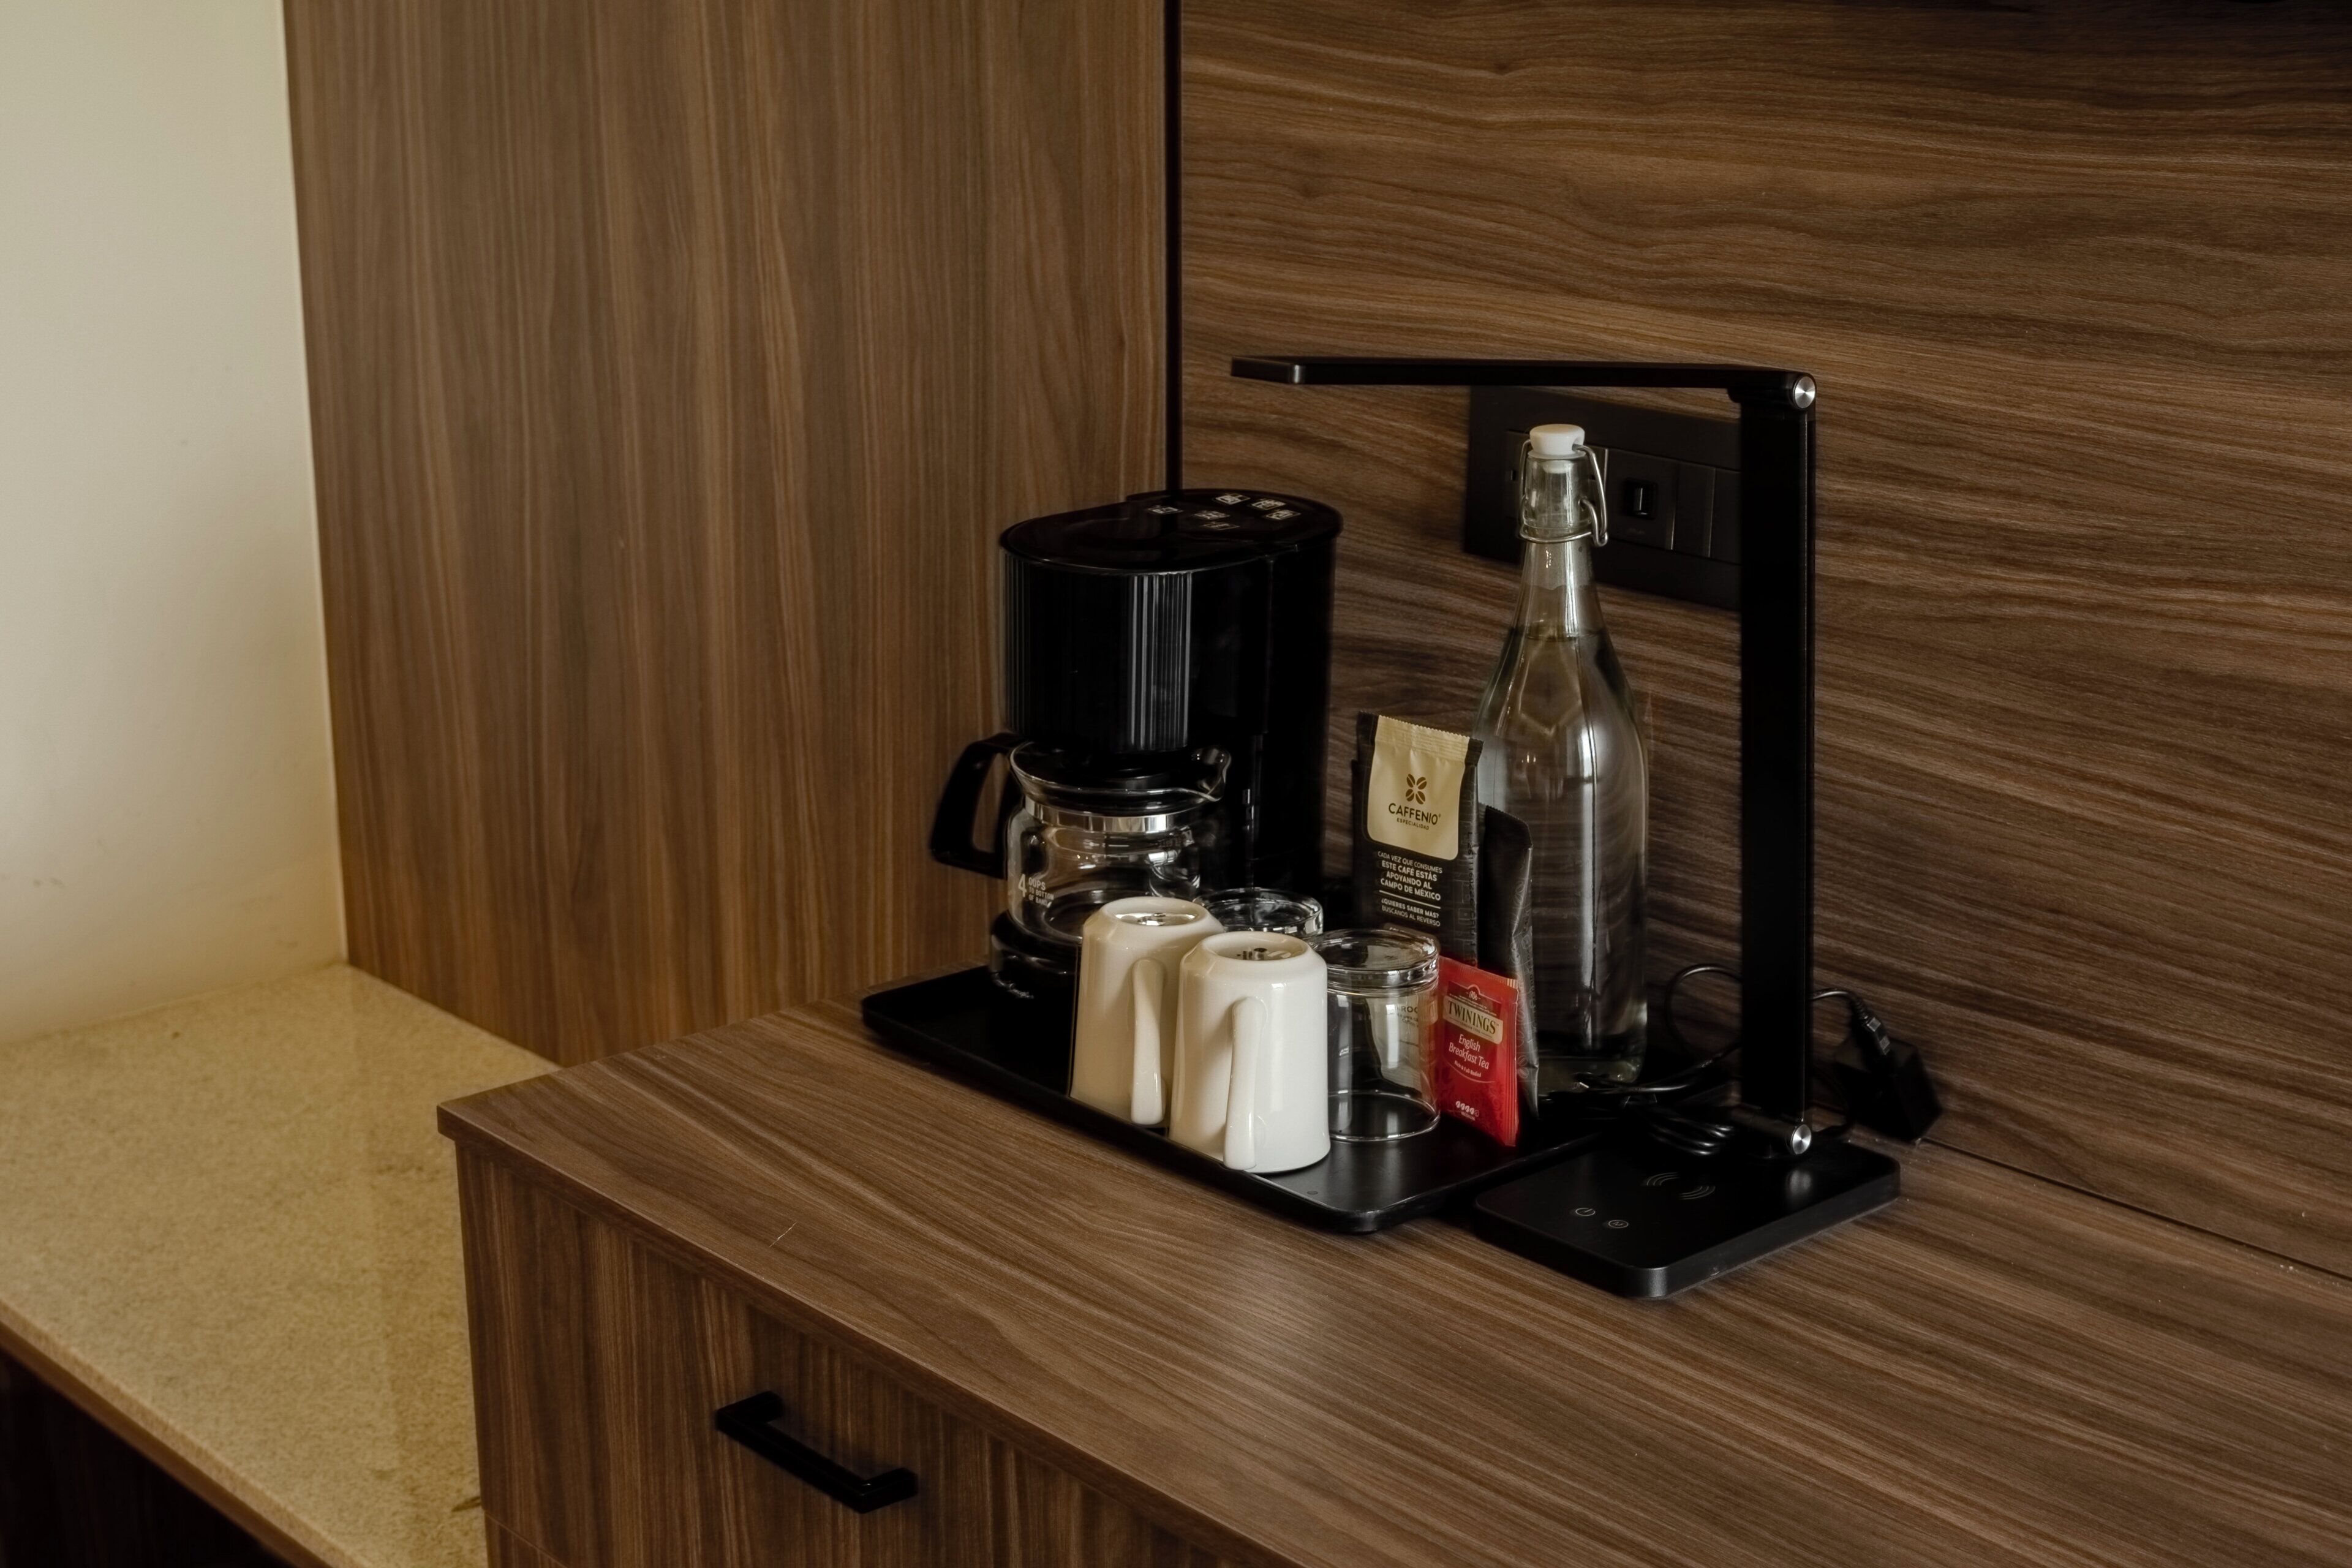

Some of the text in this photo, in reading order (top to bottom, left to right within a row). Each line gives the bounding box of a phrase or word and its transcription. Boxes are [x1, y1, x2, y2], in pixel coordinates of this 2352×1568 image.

[1388, 802, 1438, 825] CAFFENIO
[1396, 818, 1430, 830] ESPECIALIDAD
[1378, 851, 1442, 873] CADA VEZ QUE CONSUMES
[1382, 860, 1438, 881] ESTE CAFÉ ESTÁS
[1018, 873, 1027, 897] 4
[1380, 878, 1441, 900] CAMPO DE MÉXICO
[1386, 870, 1432, 890] APOYANDO AL
[1381, 898, 1439, 918] ¿QUIERES SABER MÁS?
[1417, 916, 1441, 927] REVERSO
[1448, 1000, 1496, 1035] TWININGS
[1458, 1033, 1480, 1052] English
[1449, 1042, 1490, 1070] Breakfast Tea
